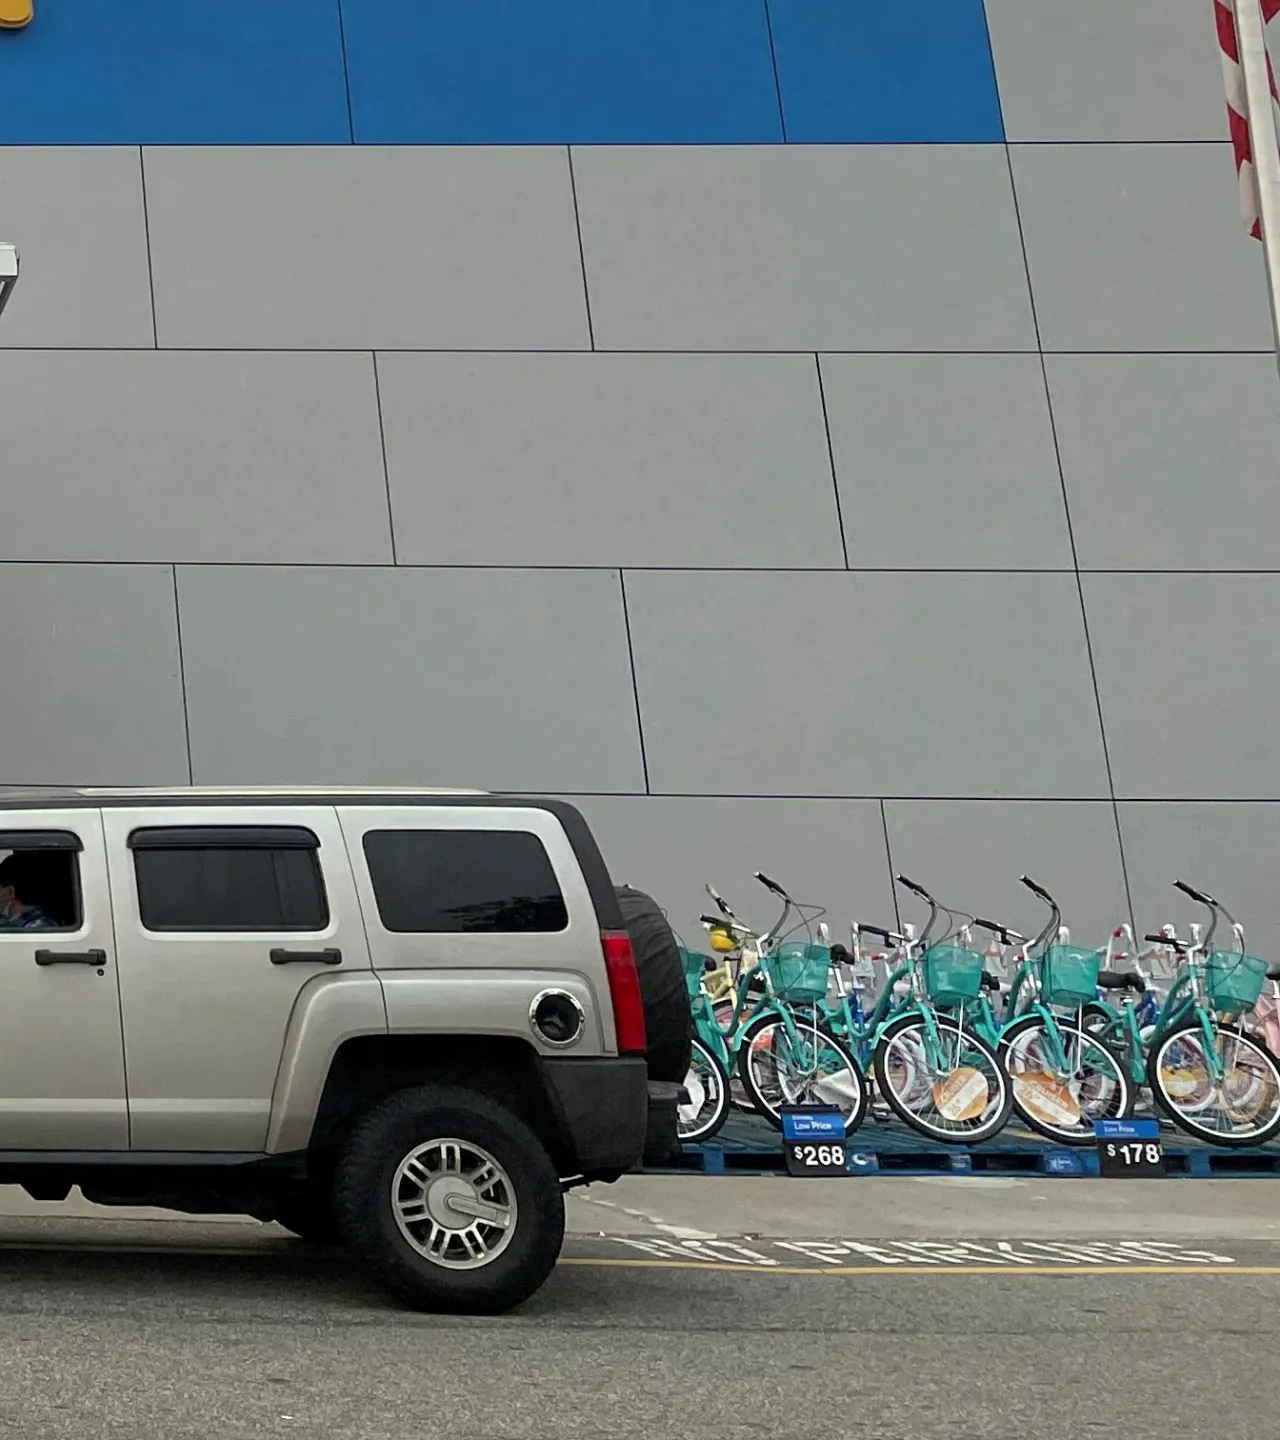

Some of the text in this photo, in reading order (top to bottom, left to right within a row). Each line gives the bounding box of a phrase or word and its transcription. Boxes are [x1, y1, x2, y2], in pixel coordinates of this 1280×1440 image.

[794, 1146, 844, 1166] $268
[608, 1237, 1236, 1265] NO PARKING
